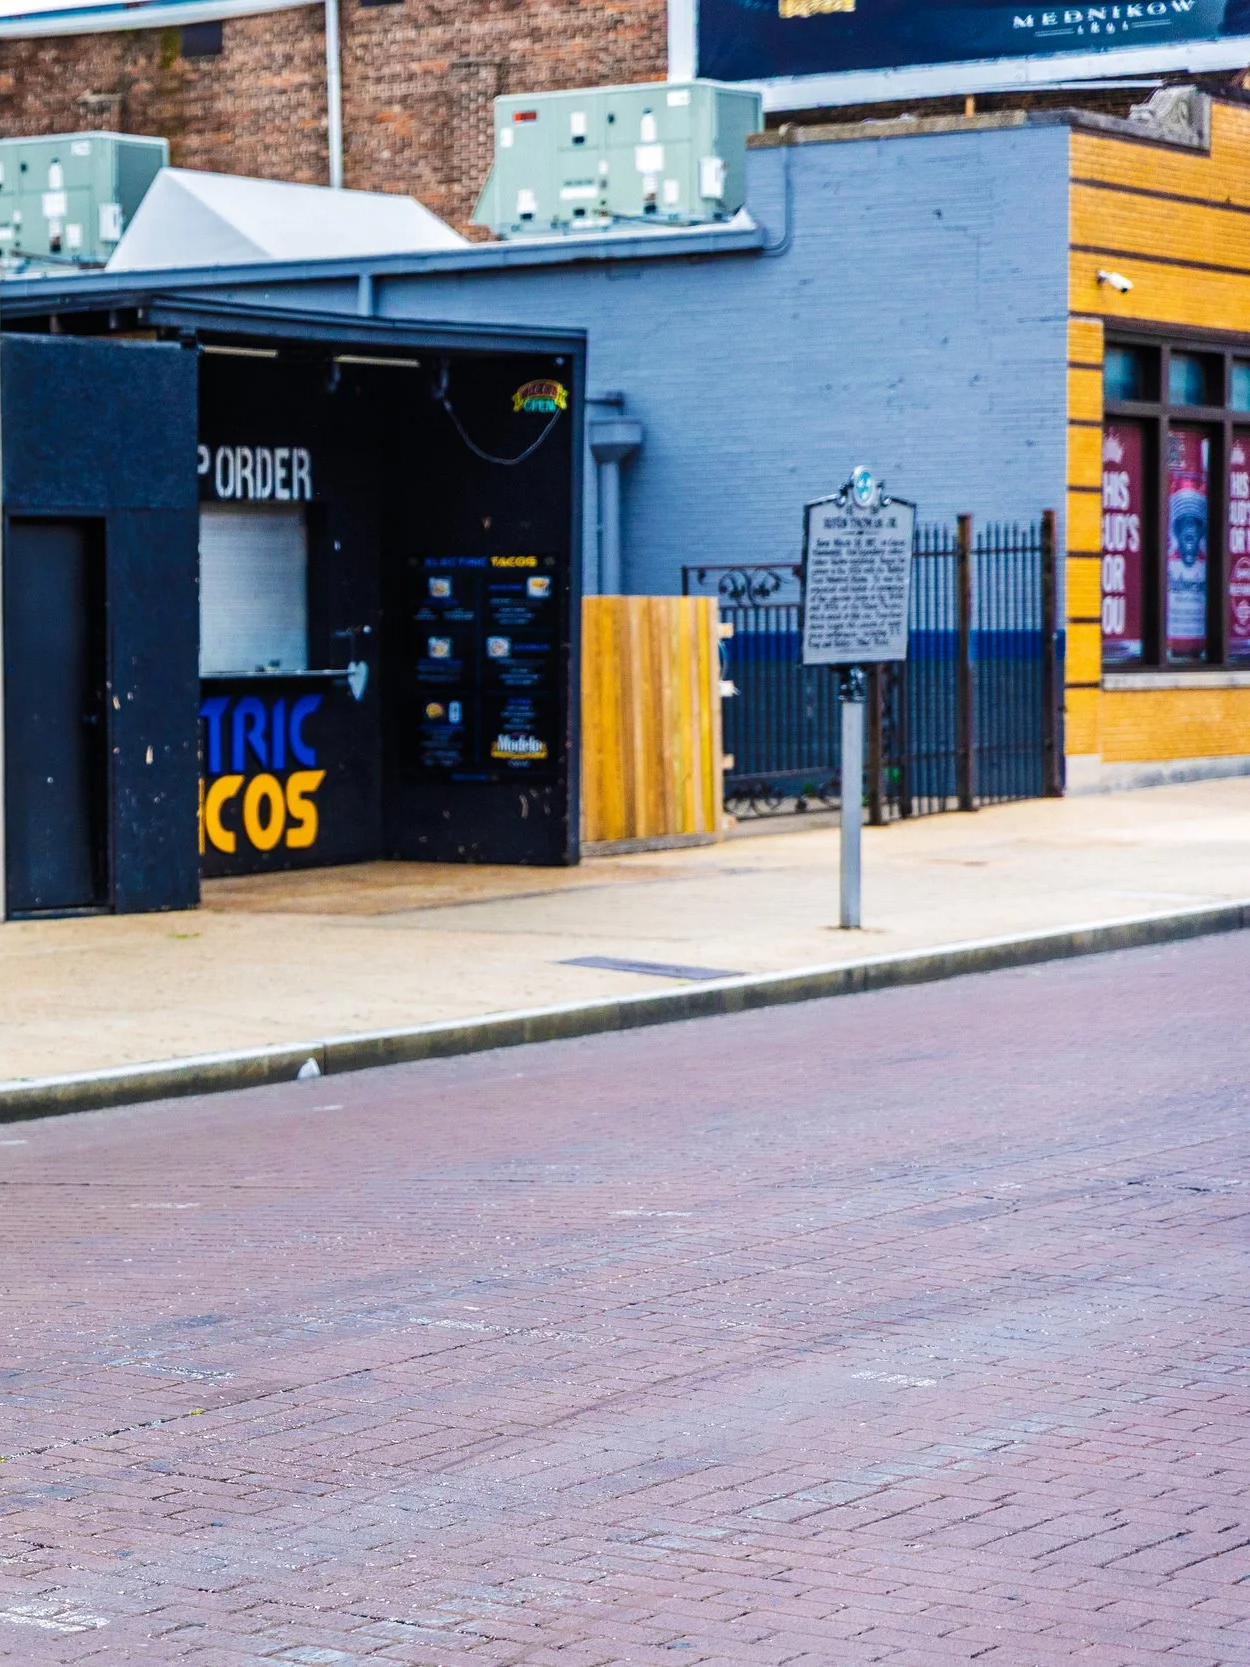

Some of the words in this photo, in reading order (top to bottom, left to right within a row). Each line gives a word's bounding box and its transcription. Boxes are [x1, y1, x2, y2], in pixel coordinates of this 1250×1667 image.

[1013, 0, 1195, 28] MEDNIKOW
[523, 397, 557, 412] OPEN
[198, 444, 211, 475] P
[215, 446, 313, 500] ORDER
[1102, 471, 1129, 511] HIS
[1230, 471, 1249, 498] HIS
[1101, 513, 1140, 552] UD'S
[1230, 527, 1245, 553] OR
[490, 555, 538, 568] TACOS
[1102, 554, 1125, 593] OR
[1102, 595, 1125, 634] OU
[200, 694, 323, 774] TRIC
[199, 769, 327, 857] COS
